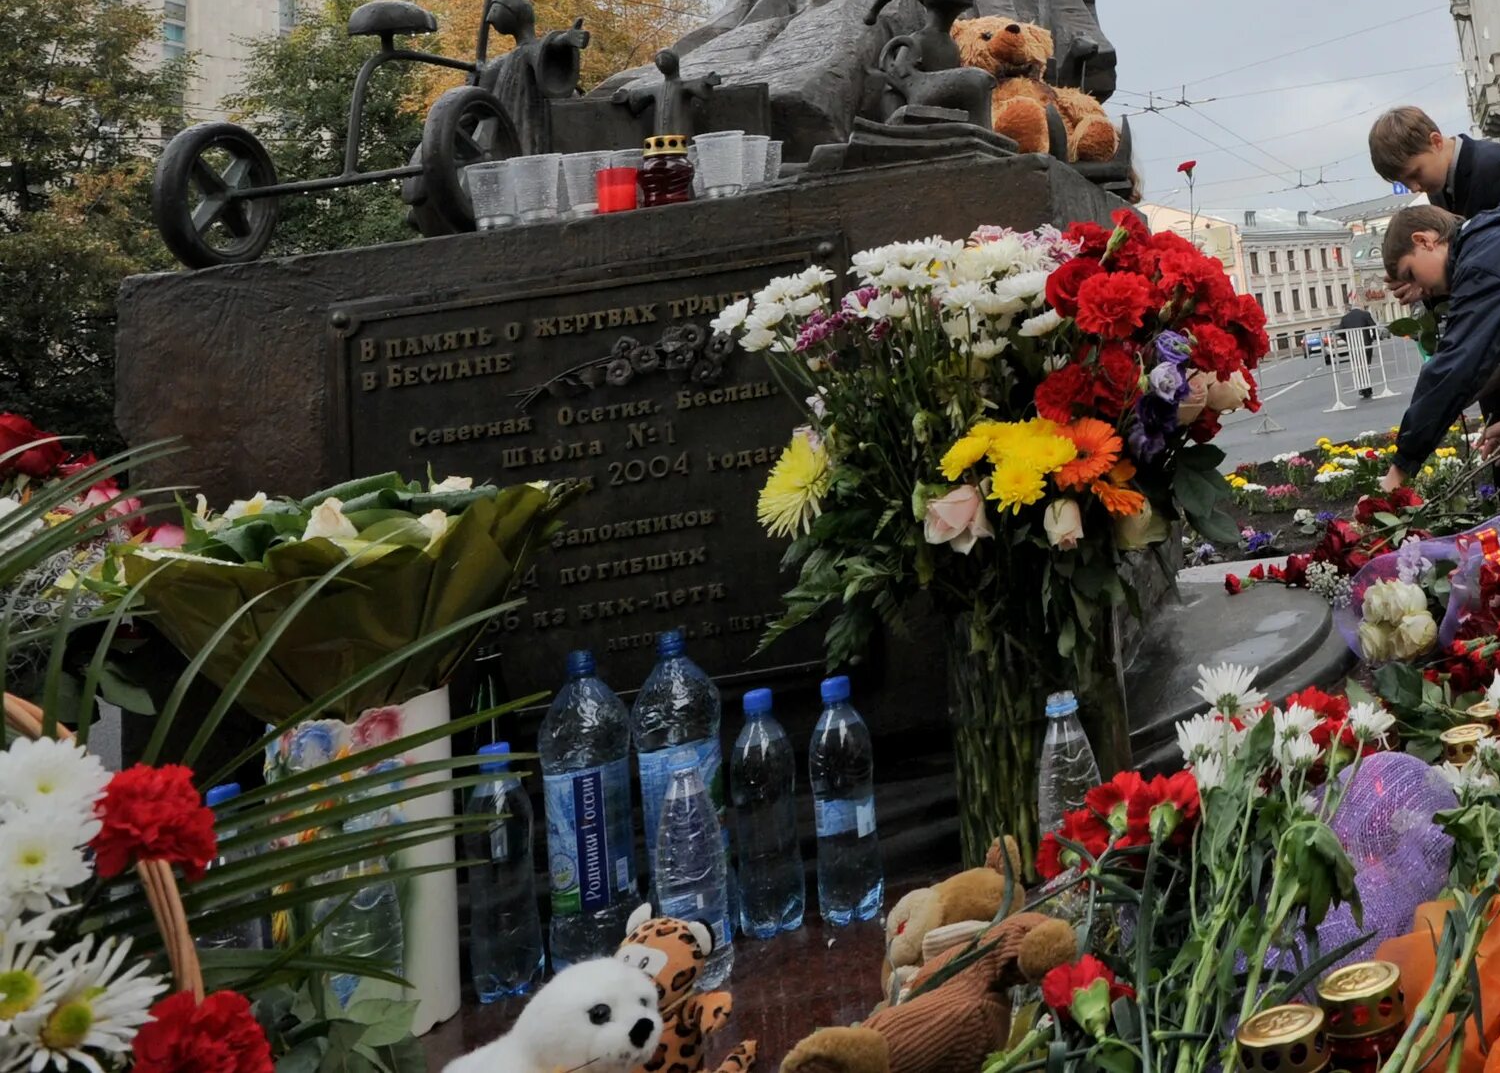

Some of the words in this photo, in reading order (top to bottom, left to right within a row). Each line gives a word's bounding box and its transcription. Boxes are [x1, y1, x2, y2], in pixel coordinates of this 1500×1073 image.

[360, 338, 377, 362] В
[385, 326, 493, 359] ПАМЯТЬ
[504, 321, 522, 341] О
[534, 302, 659, 337] ЖЕРТВАХ
[387, 353, 513, 388] БЕСЛАНЕ
[409, 416, 534, 446] Северная
[502, 439, 603, 469] Школа
[607, 451, 690, 487] 2004
[551, 508, 716, 550] заложников
[559, 546, 707, 586] погибших
[532, 607, 567, 630] из
[585, 832, 602, 902] Родники
